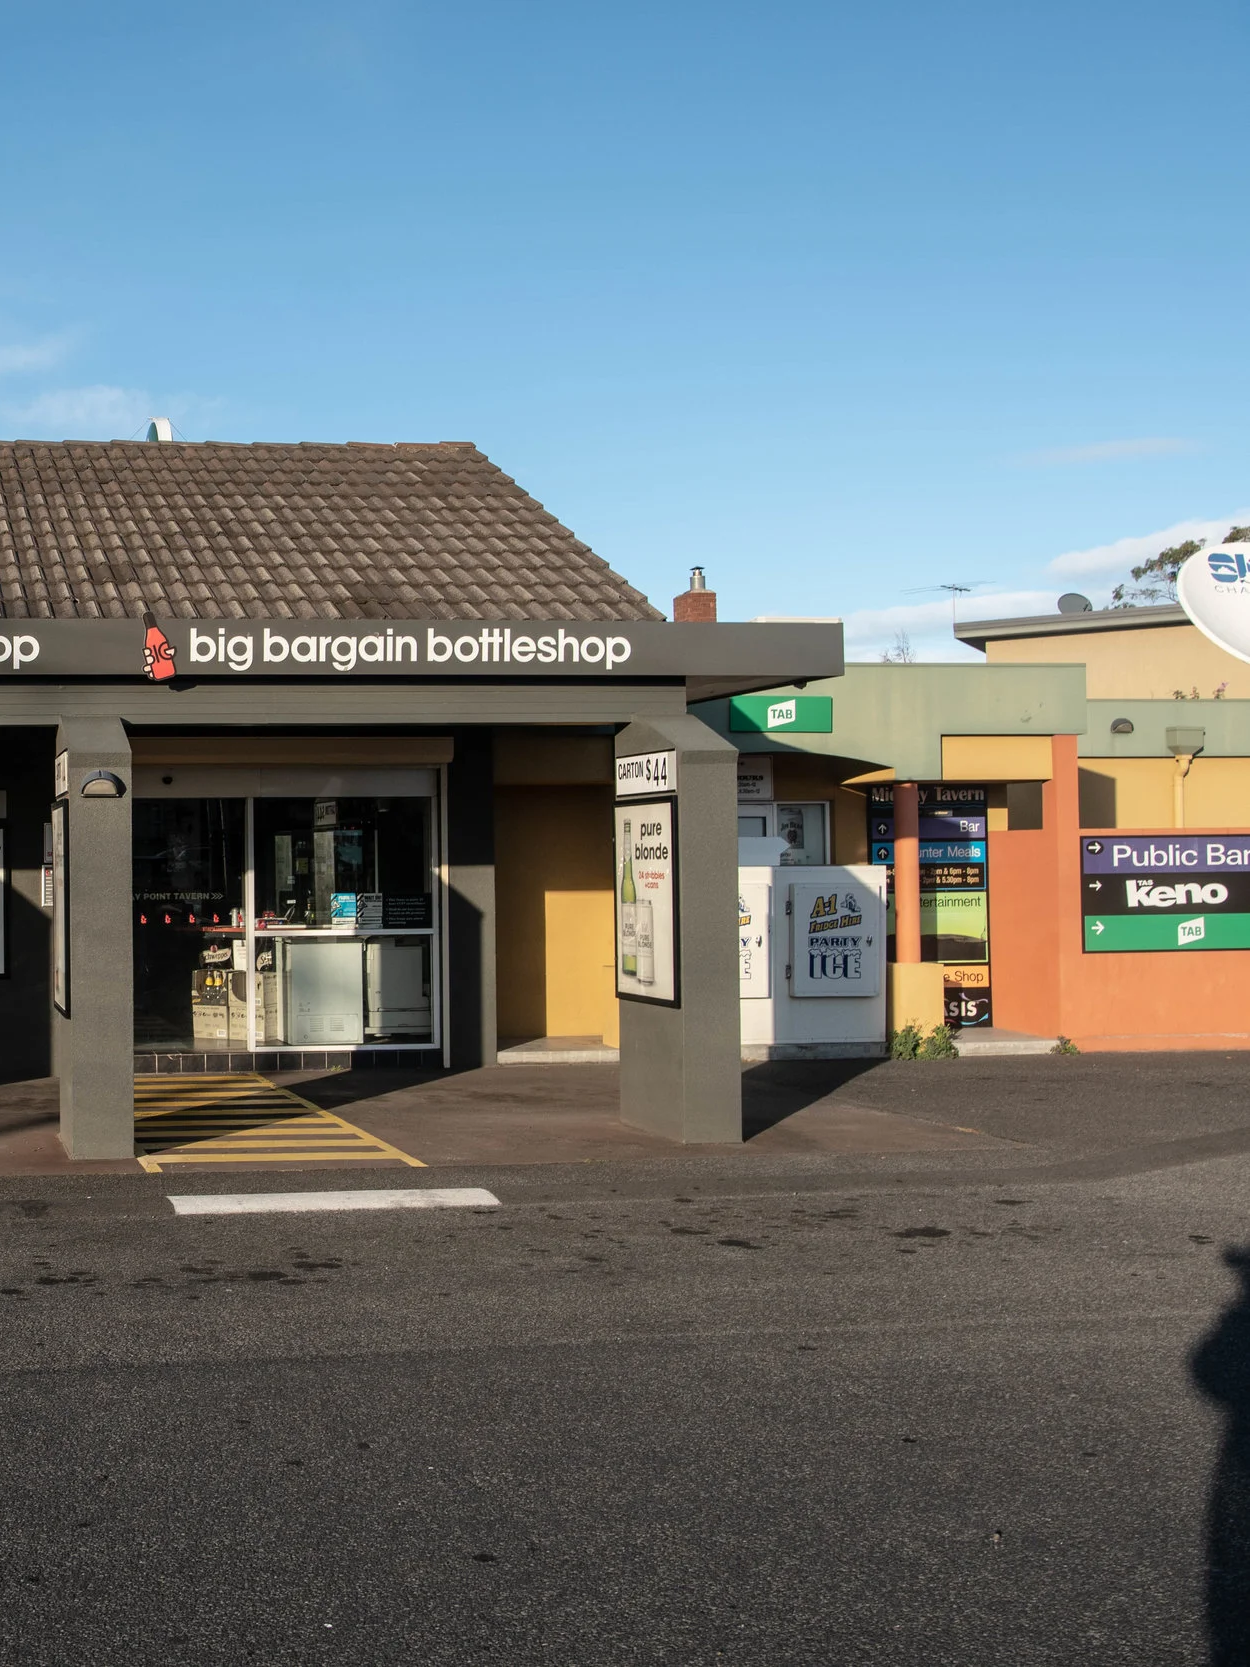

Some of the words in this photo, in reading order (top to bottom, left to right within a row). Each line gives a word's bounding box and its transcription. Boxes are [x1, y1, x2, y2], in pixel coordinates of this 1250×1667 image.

[190, 627, 254, 672] big
[264, 627, 418, 672] bargain
[428, 627, 632, 670] bottleshop
[771, 709, 793, 719] TAB
[618, 761, 644, 780] CARTON
[646, 757, 667, 786] $44
[935, 786, 985, 801] Tavern
[640, 822, 662, 840] pure
[960, 820, 980, 832] Bar
[635, 843, 668, 860] blonde
[918, 847, 944, 857] unter
[947, 845, 981, 857] Meals
[1112, 844, 1199, 867] Public
[1206, 843, 1250, 866] Bar
[145, 892, 171, 900] POINT
[174, 892, 210, 900] TAVERN
[920, 896, 981, 908] tertainment
[1180, 927, 1203, 936] TAB
[808, 936, 862, 948] PARTY
[808, 948, 862, 980] ICE
[954, 971, 984, 983] Shop
[944, 1001, 977, 1017] SIS
